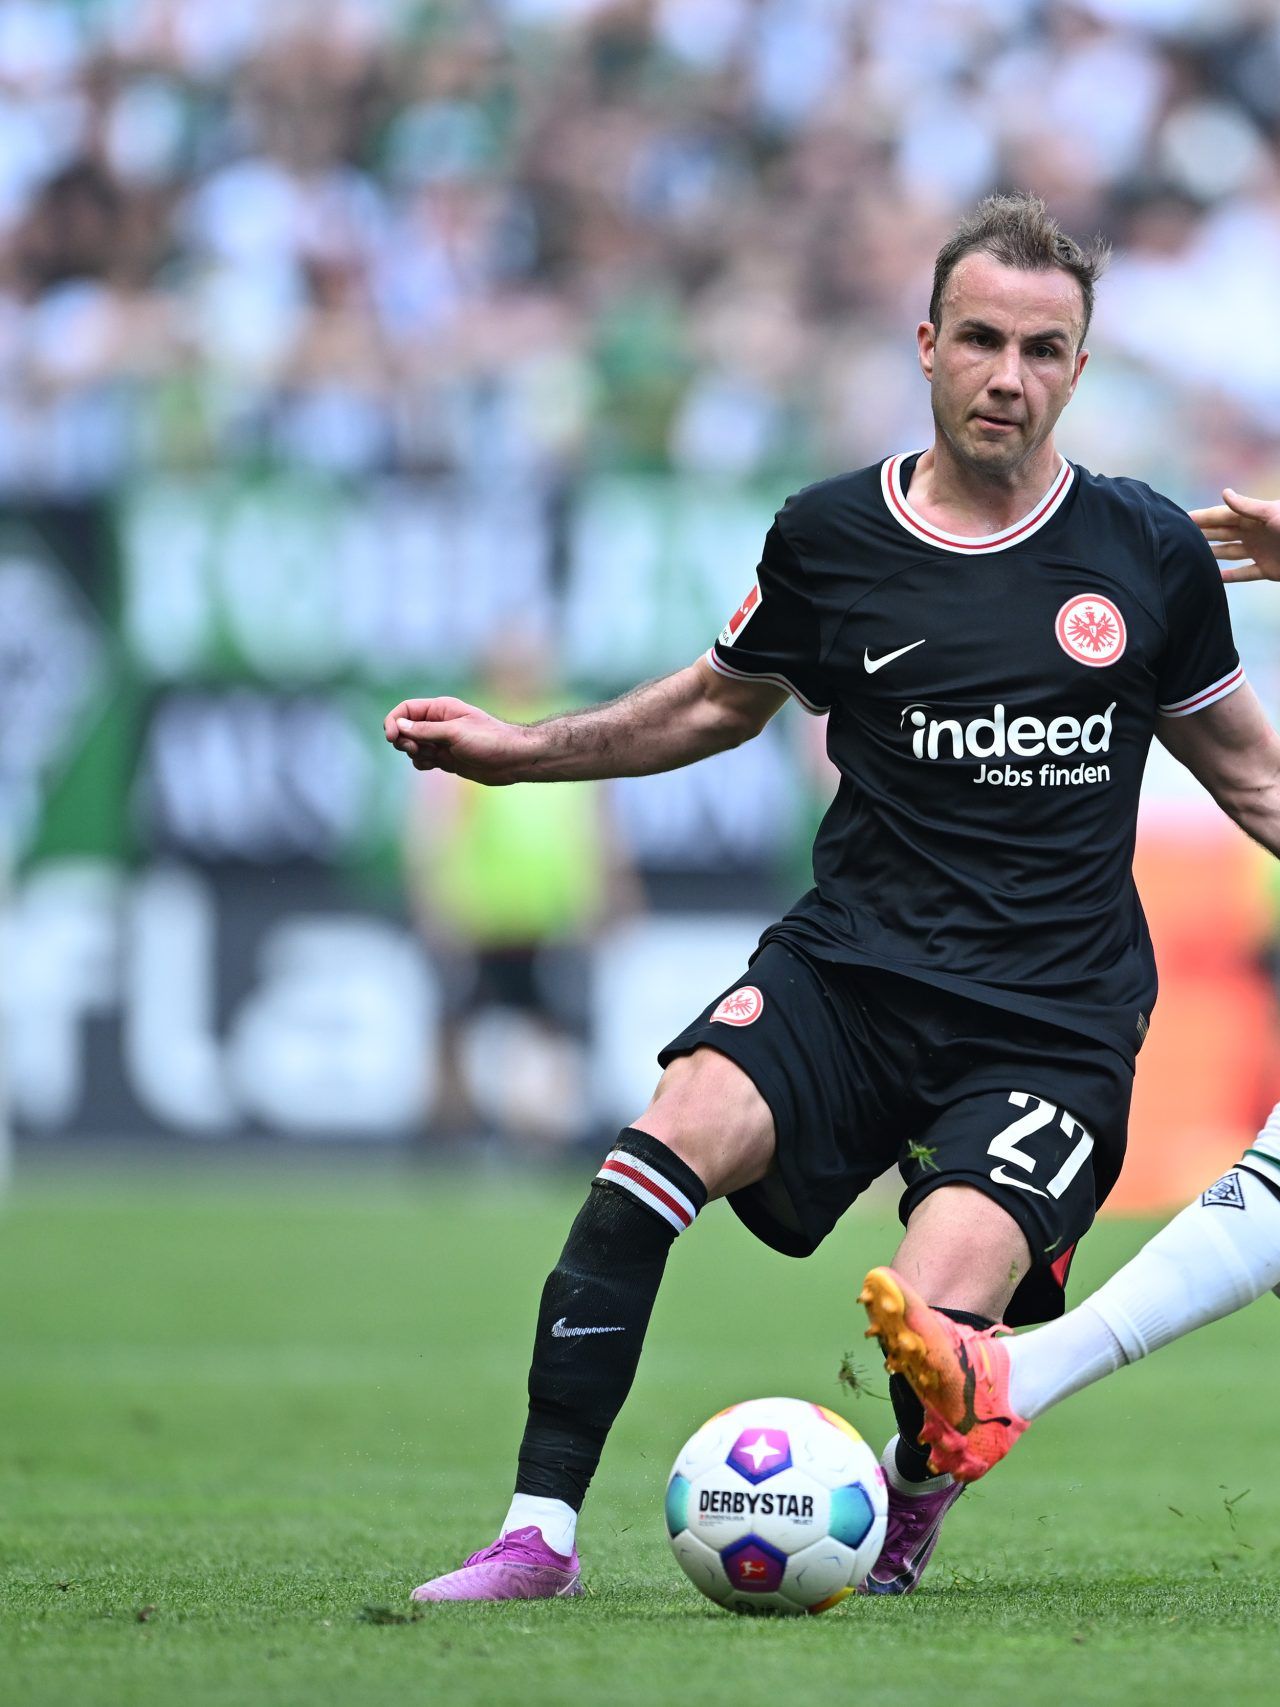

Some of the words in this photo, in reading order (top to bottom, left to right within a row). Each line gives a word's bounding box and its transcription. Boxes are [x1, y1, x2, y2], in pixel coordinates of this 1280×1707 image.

[901, 702, 1117, 760] indeed
[973, 764, 1033, 787] Jobs
[1039, 763, 1111, 786] finden
[986, 1091, 1095, 1200] 27
[699, 1490, 814, 1517] DERBYSTAR
